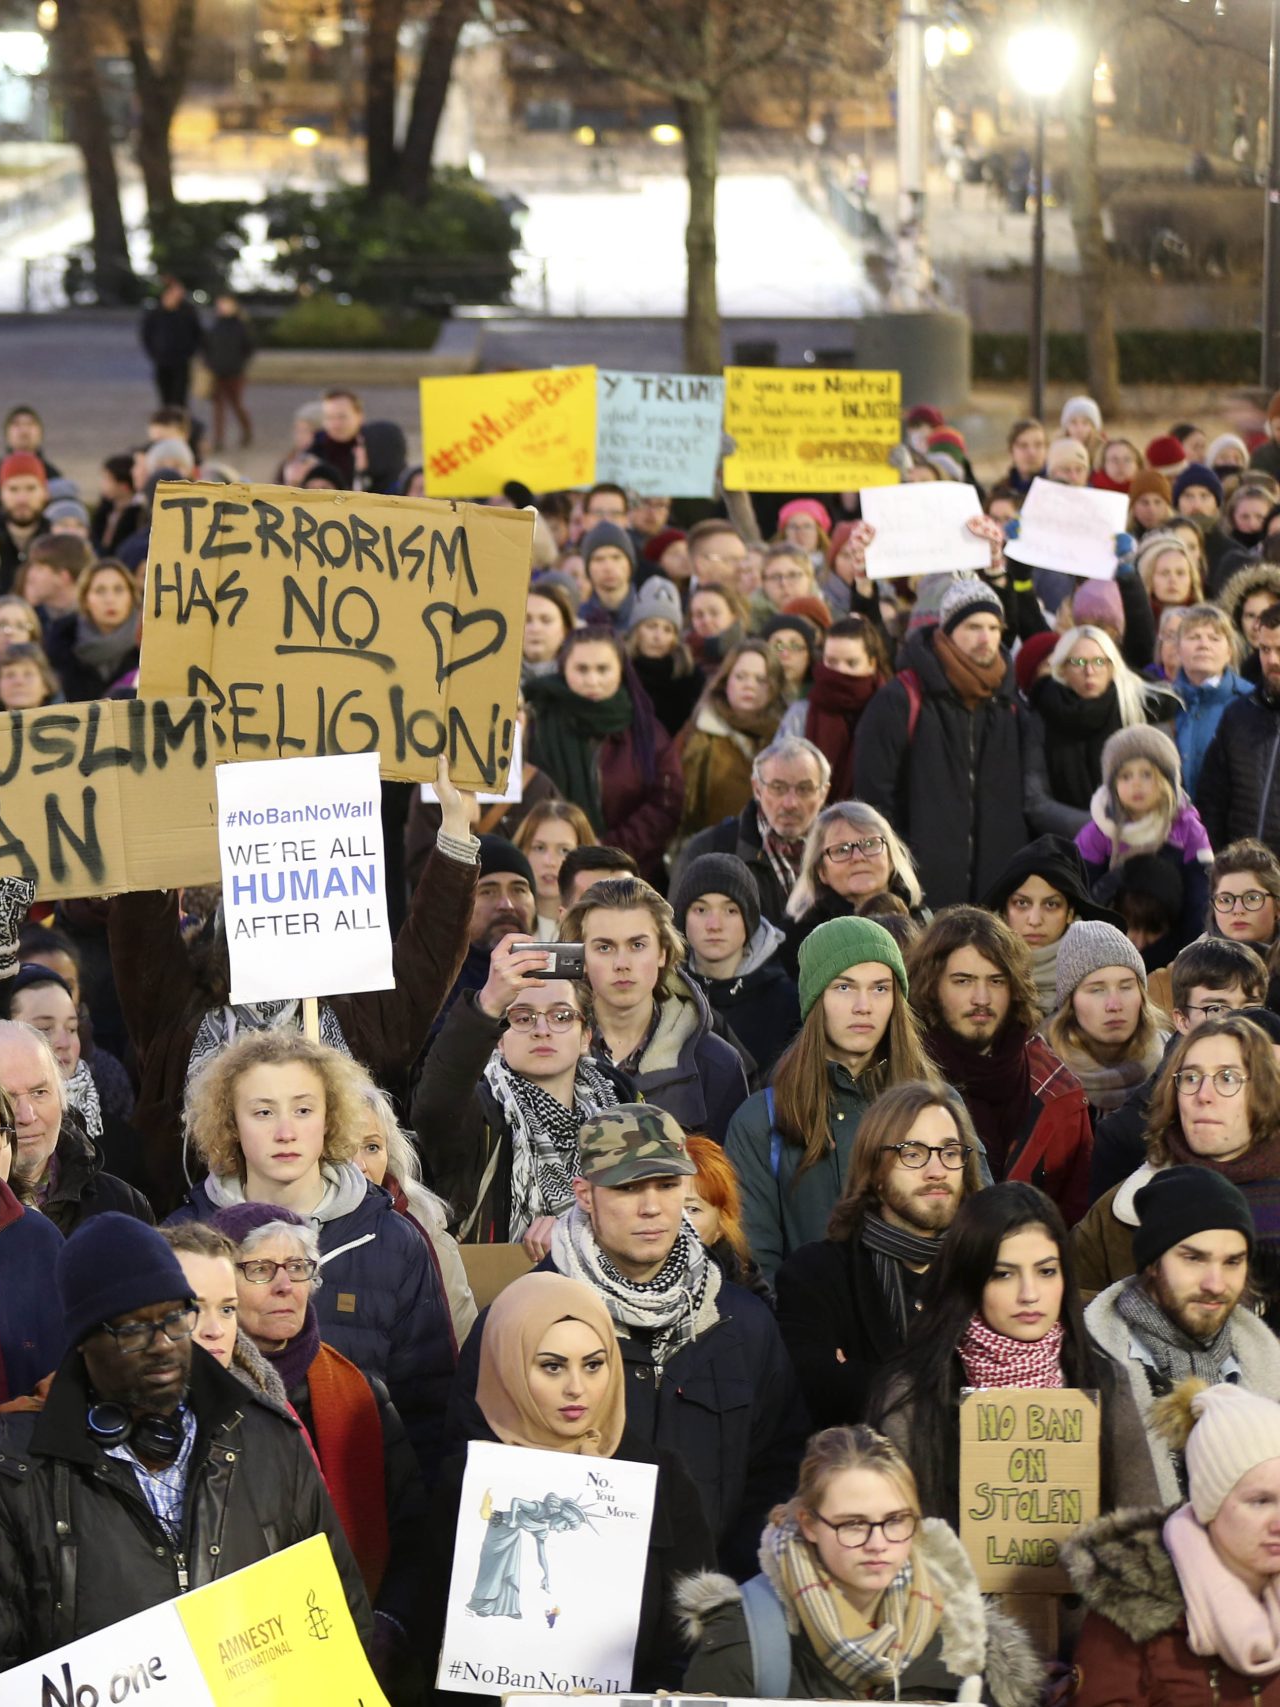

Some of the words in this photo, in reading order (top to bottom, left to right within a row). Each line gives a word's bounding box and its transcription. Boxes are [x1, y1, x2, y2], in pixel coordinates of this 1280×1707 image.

[632, 376, 718, 403] TRUM
[160, 497, 479, 597] TERRORISM
[154, 562, 249, 627] HAS
[283, 575, 381, 651] NO
[226, 801, 373, 828] #NoBanNoWall
[330, 835, 376, 859] ALL
[231, 864, 377, 906] HUMAN
[233, 911, 320, 940] AFTER
[334, 907, 381, 932] ALL
[976, 1403, 1017, 1442] NO
[1026, 1403, 1082, 1443] BAN
[586, 1471, 614, 1489] No.
[1007, 1447, 1048, 1483] ON
[595, 1490, 616, 1503] You
[606, 1505, 641, 1520] Move.
[969, 1482, 1081, 1524] STOLEN
[986, 1535, 1059, 1568] LAND
[218, 1614, 285, 1665] AMNESTY
[225, 1640, 293, 1682] INTERNATIONAL
[448, 1660, 621, 1694] #NoBanNoWall
[109, 1655, 168, 1704] one
